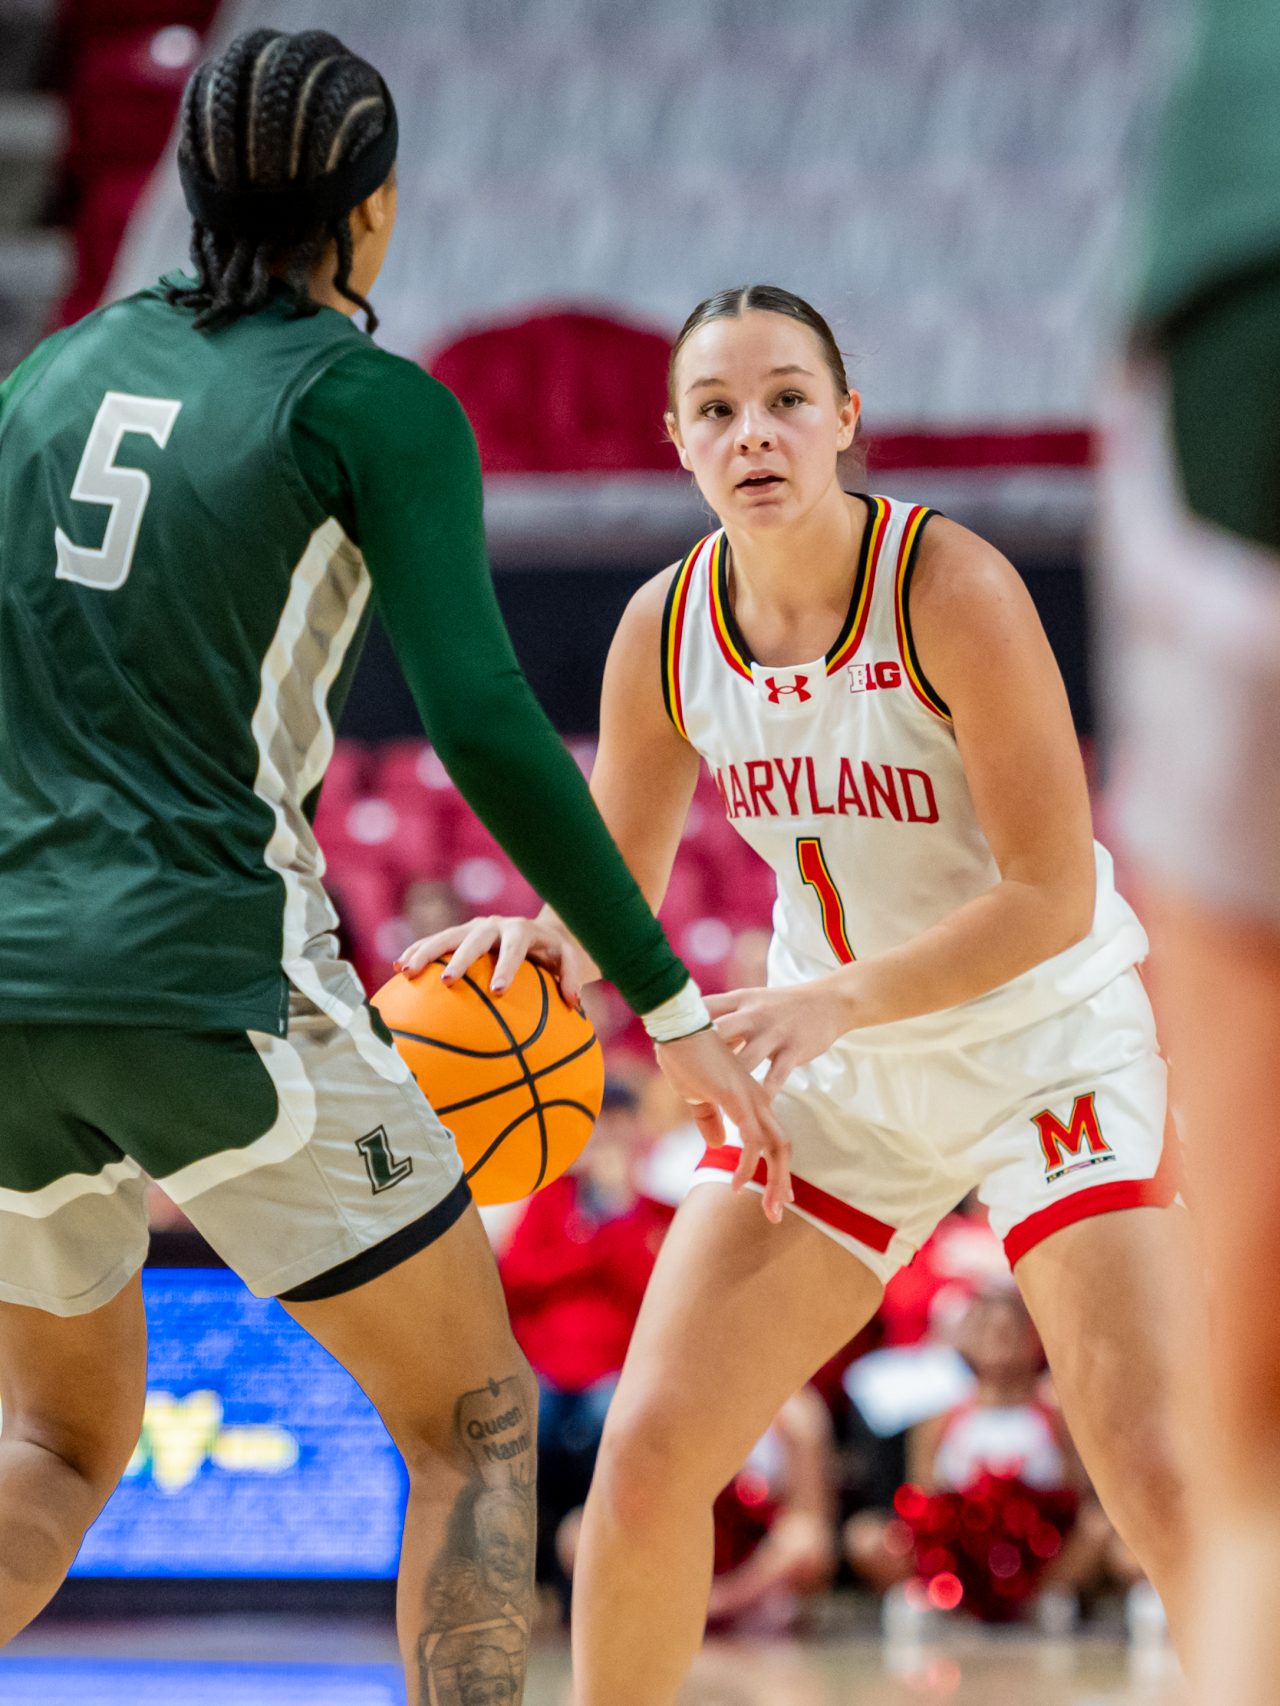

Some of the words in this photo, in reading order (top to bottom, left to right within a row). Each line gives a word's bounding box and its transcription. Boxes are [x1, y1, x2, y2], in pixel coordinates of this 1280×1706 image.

[55, 390, 183, 590] 5
[796, 837, 857, 966] 1
[355, 1124, 413, 1196] L
[1030, 1091, 1112, 1173] M
